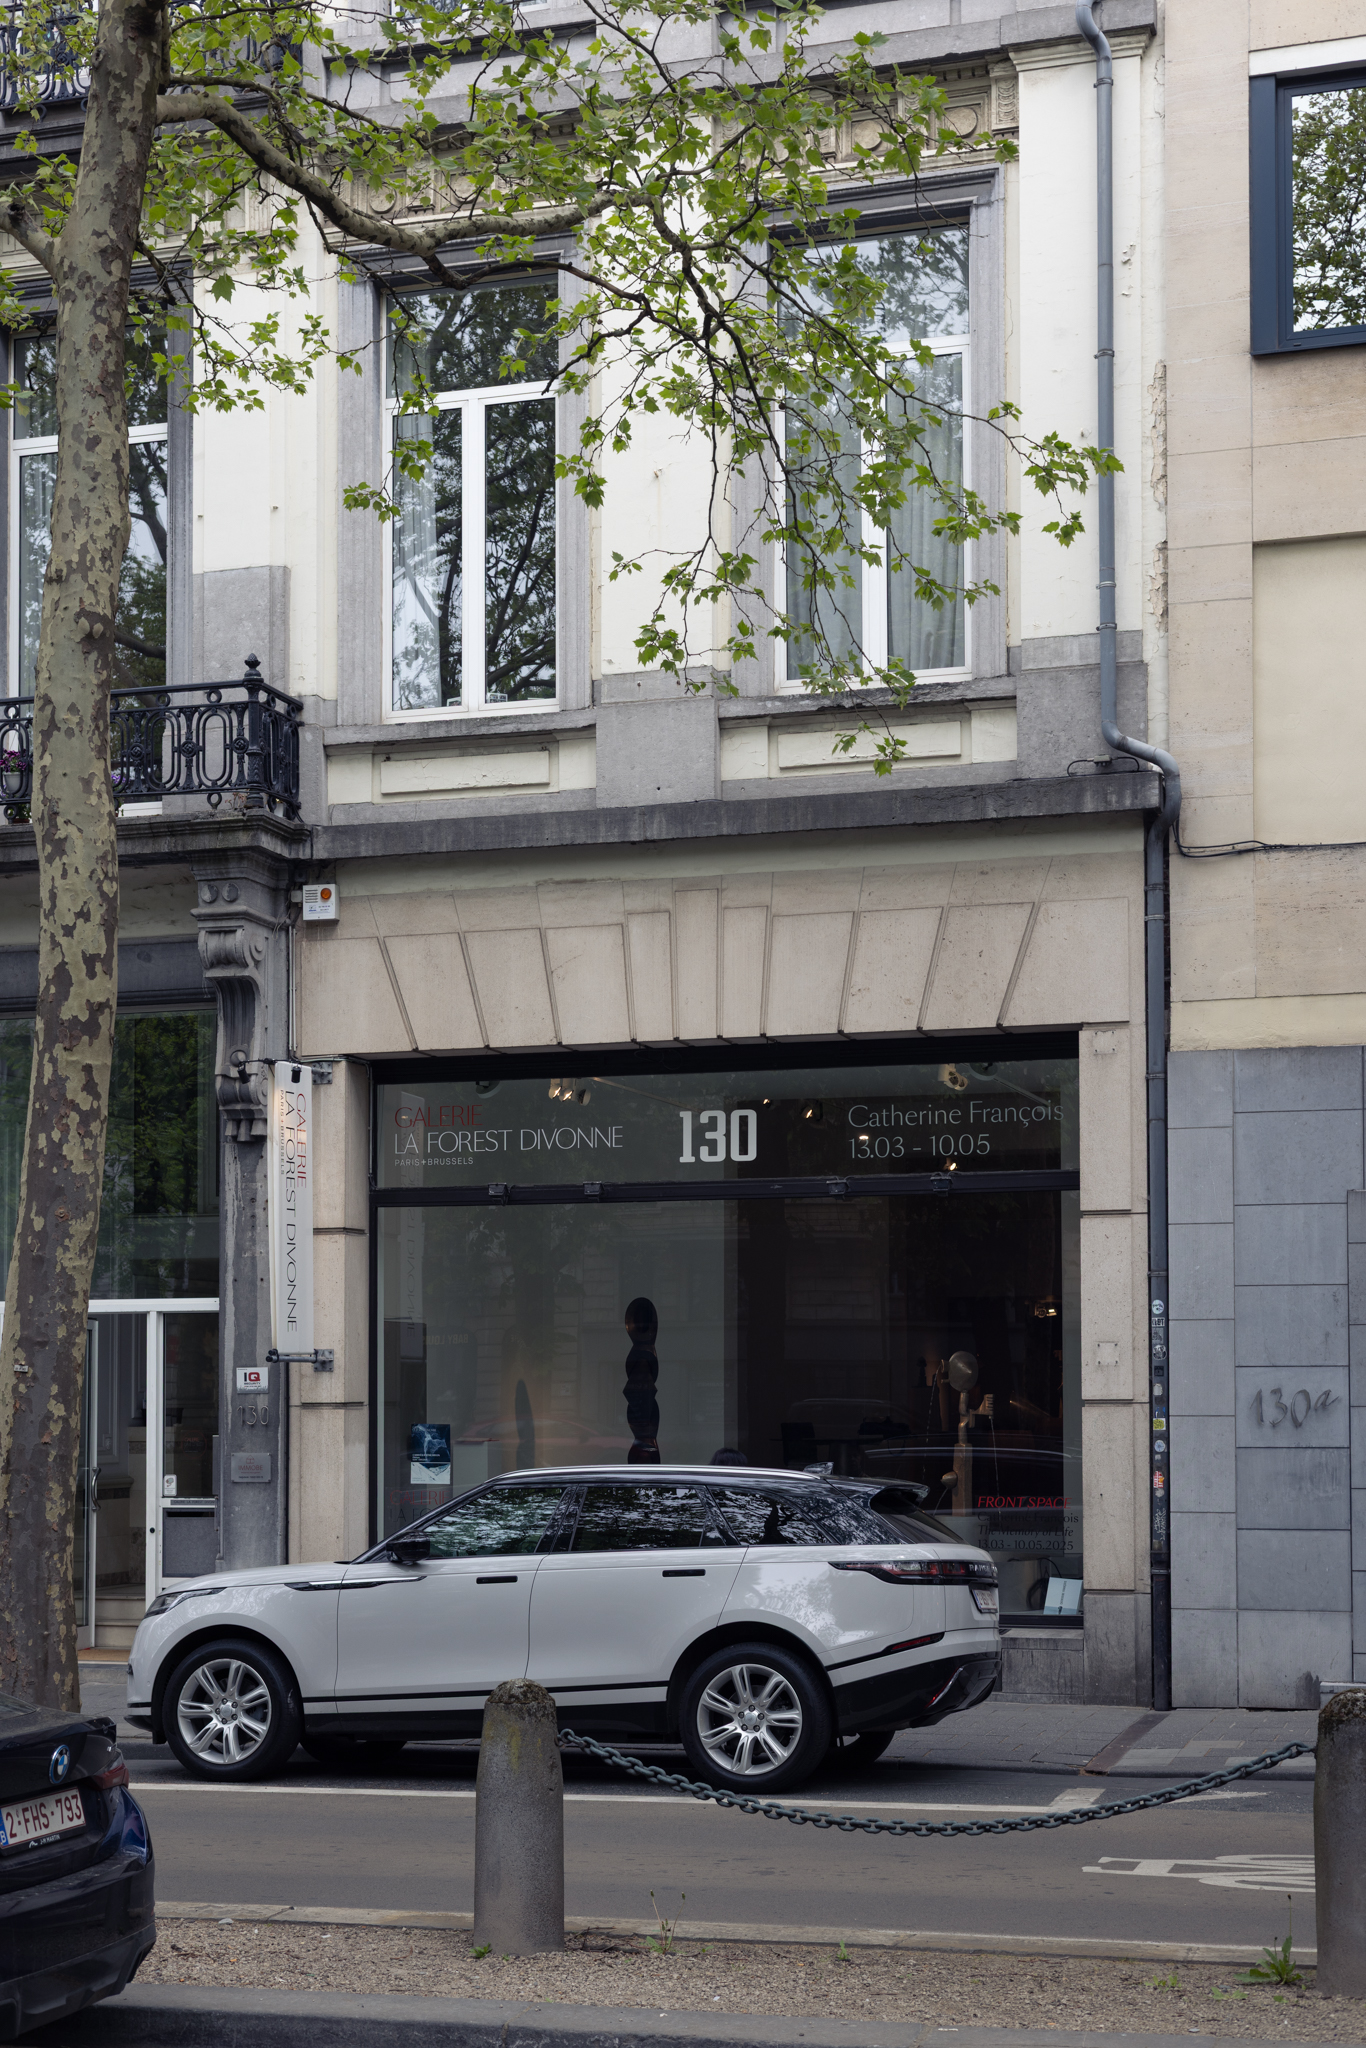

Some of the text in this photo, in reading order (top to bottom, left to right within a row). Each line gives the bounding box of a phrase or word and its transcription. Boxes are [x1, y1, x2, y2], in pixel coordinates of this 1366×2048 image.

[394, 1104, 484, 1129] GALERIE
[848, 1100, 1064, 1129] Catherine François
[296, 1093, 307, 1188] GALERIE
[394, 1125, 624, 1155] LA FOREST DIVONNE
[679, 1108, 758, 1163] 130
[848, 1136, 905, 1158] 13.03
[929, 1133, 991, 1157] 10.05
[285, 1091, 298, 1333] LA FOREST DIVONNE
[244, 1371, 261, 1382] IQ
[237, 1405, 269, 1425] 130
[389, 1489, 451, 1506] GALERIE
[977, 1495, 1073, 1509] FRONT SPACE
[977, 1511, 1079, 1524] Catherine François
[978, 1524, 1074, 1538] The Memory of Life
[977, 1539, 1004, 1549] 13.03
[1014, 1539, 1074, 1551] 10.05.2025
